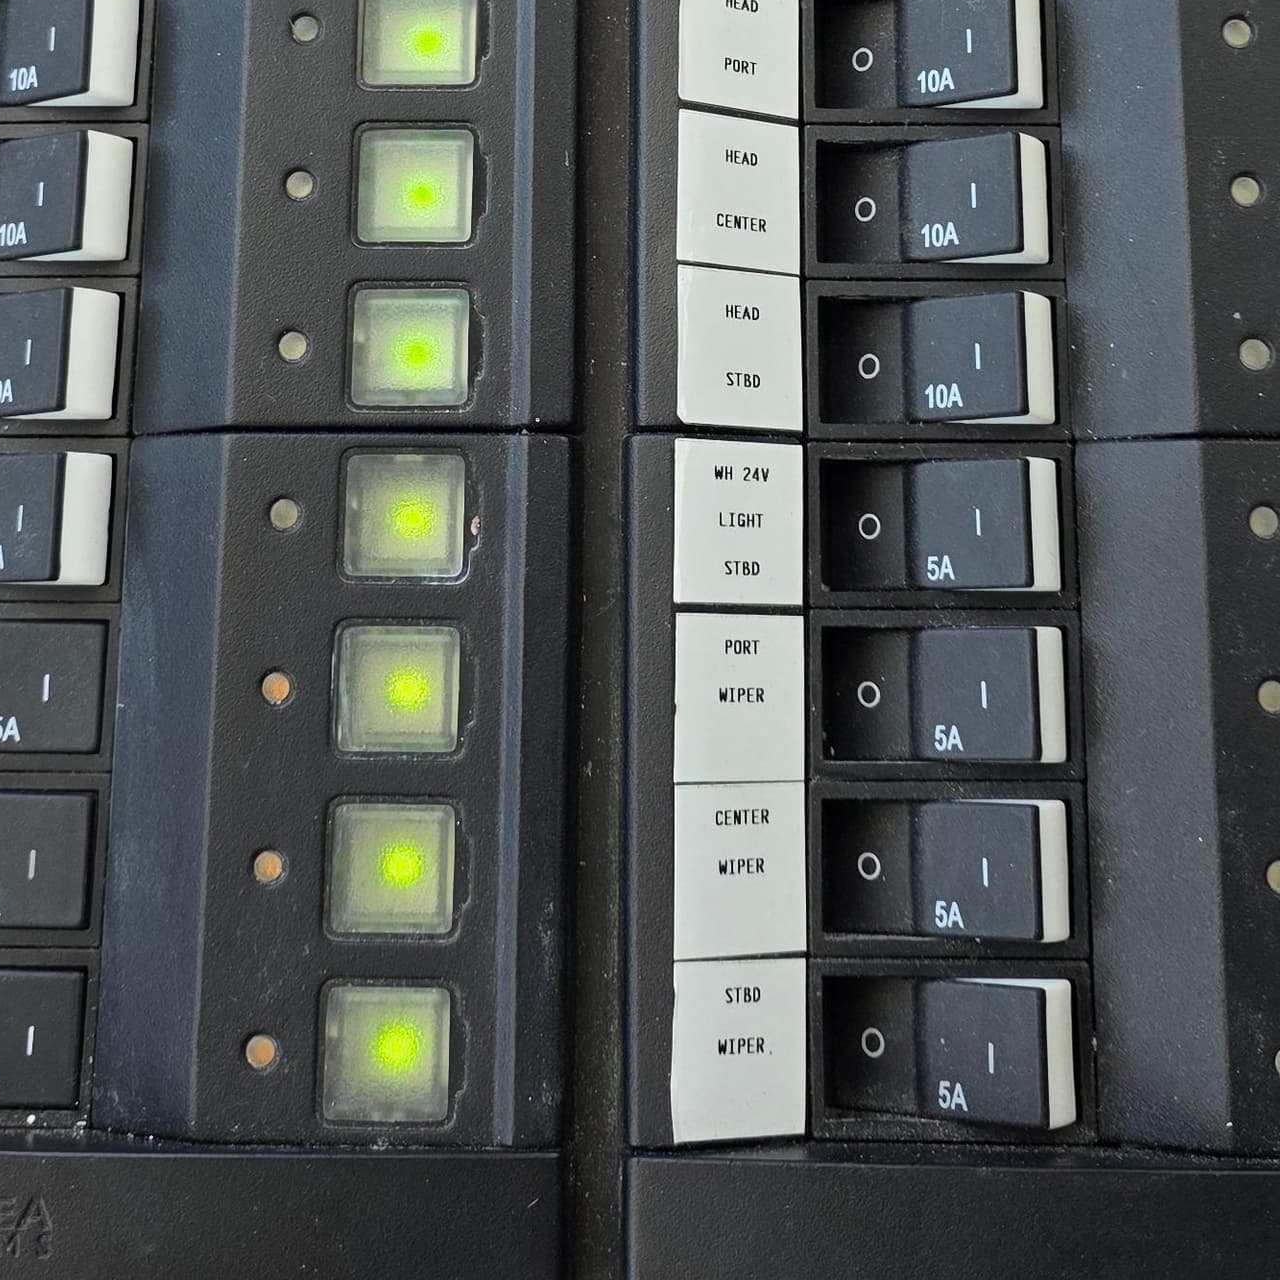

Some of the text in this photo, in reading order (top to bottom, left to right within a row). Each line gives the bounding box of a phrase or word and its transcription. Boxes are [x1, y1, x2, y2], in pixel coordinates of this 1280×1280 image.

[723, 56, 758, 76] PORT
[8, 64, 39, 92] 10A
[916, 66, 955, 95] 10A
[725, 148, 759, 168] HEAD
[715, 213, 768, 234] CENTER
[920, 221, 960, 249] 10A
[725, 303, 760, 322] HEAD
[725, 371, 762, 389] STBD
[924, 382, 963, 410] 10A
[714, 464, 770, 483] WH 24V
[718, 511, 764, 529] LIGHT
[724, 560, 761, 577] STBD
[926, 554, 956, 581] 5A
[724, 638, 761, 656] PORT
[718, 686, 765, 704] WIPER
[933, 724, 964, 752] 5A
[714, 807, 770, 827] CENTER
[717, 857, 766, 876] WIPER
[934, 900, 965, 929] 5A
[724, 986, 762, 1005] STBD
[717, 1036, 766, 1056] WIPER
[937, 1079, 969, 1112] 5A
